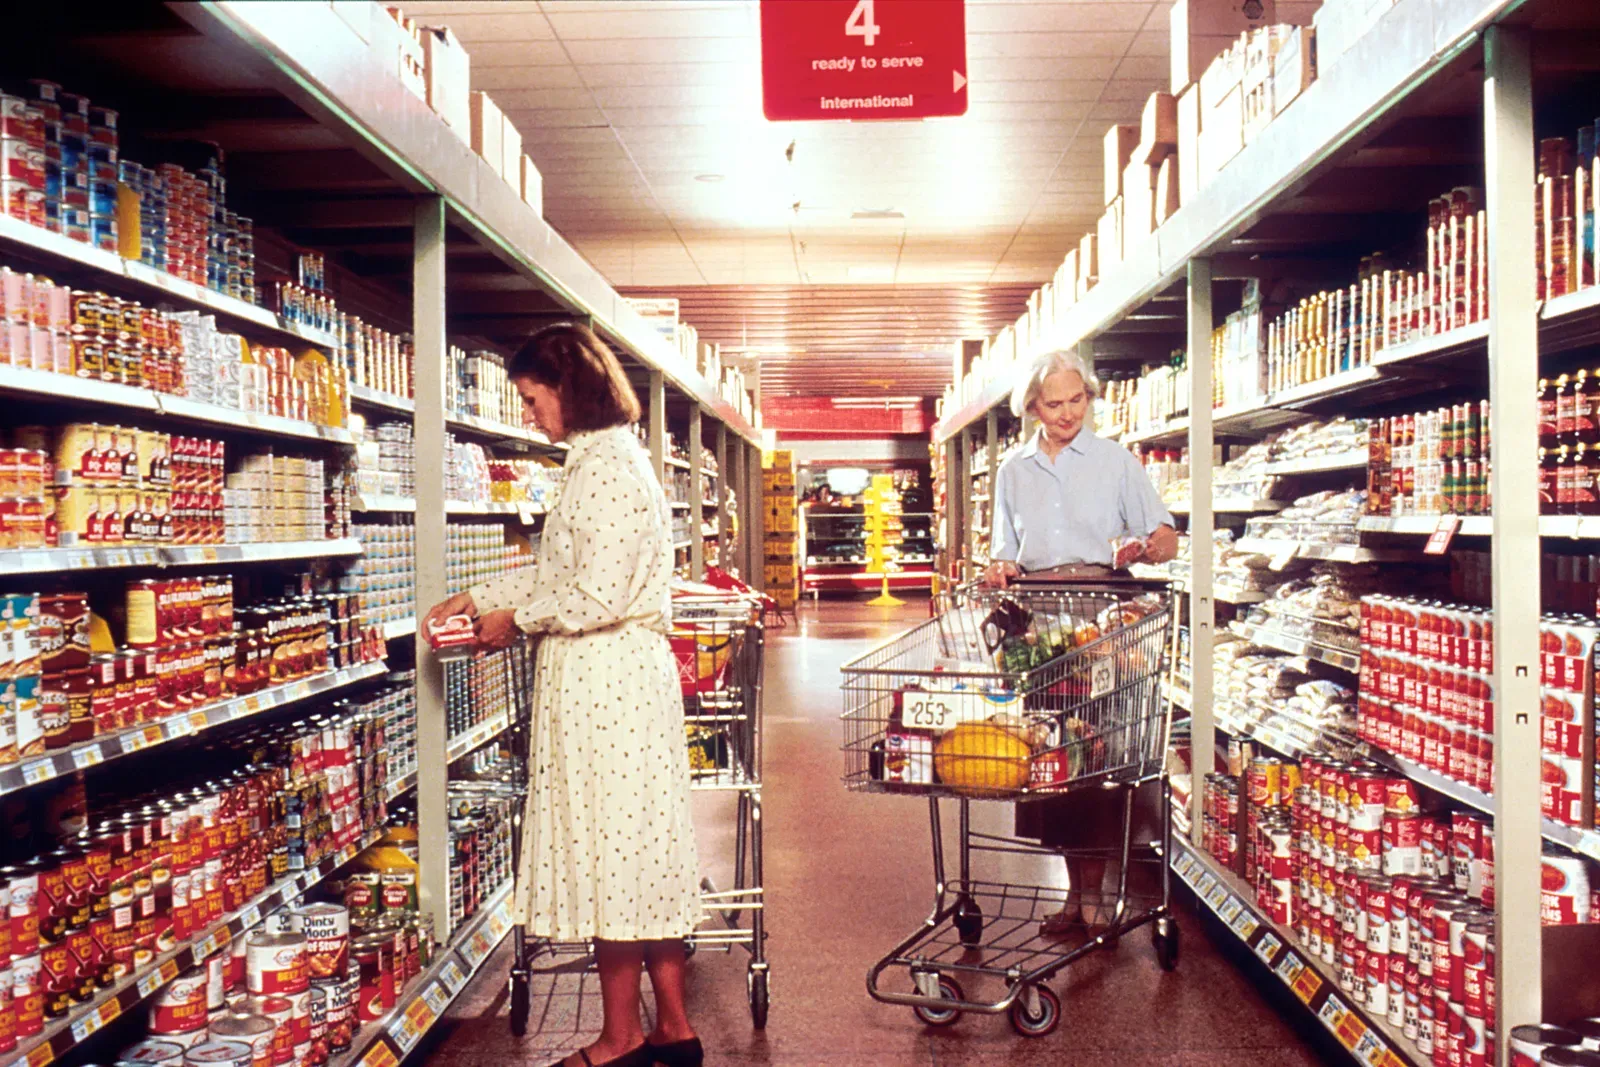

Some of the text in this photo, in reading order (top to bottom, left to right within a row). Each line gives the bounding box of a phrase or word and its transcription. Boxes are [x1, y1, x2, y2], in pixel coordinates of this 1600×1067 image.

[845, 0, 880, 46] 4
[812, 56, 923, 71] ready to serve
[821, 95, 913, 109] international
[914, 701, 946, 726] 253
[303, 917, 335, 928] Dinty
[301, 928, 338, 938] Moore
